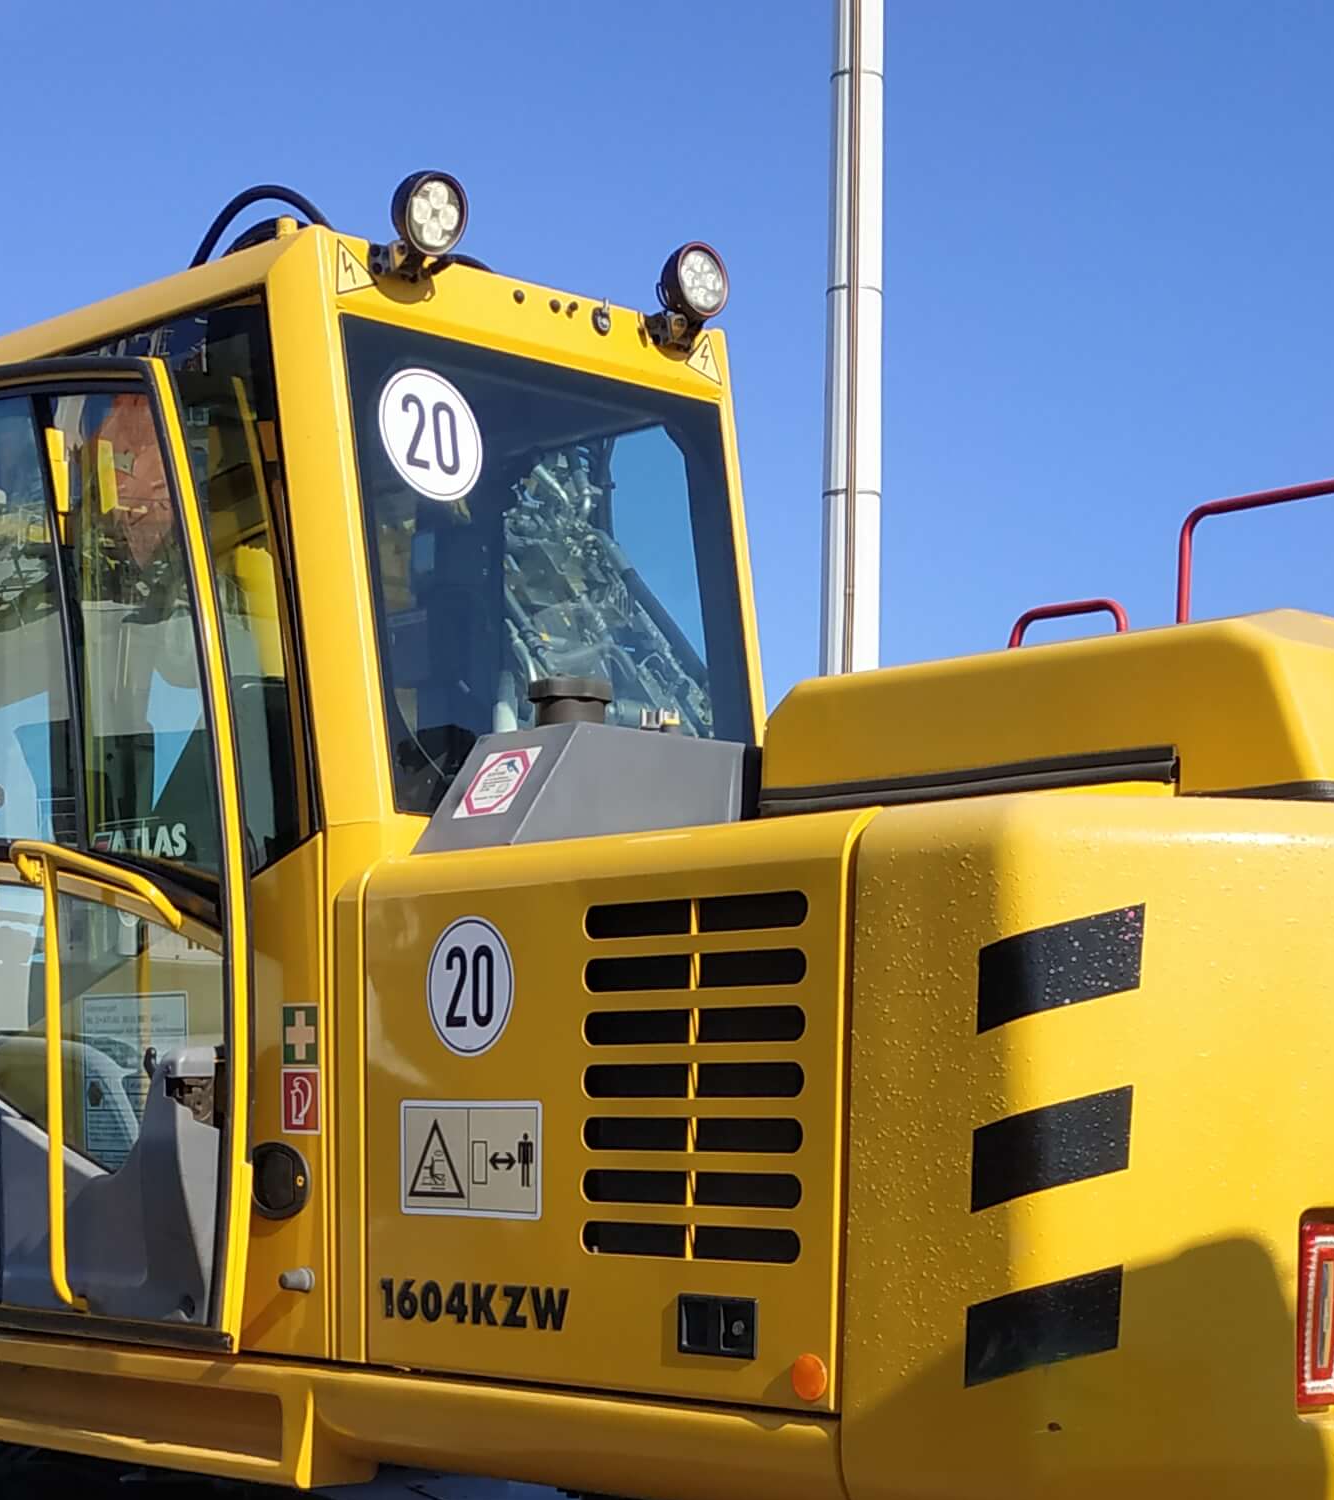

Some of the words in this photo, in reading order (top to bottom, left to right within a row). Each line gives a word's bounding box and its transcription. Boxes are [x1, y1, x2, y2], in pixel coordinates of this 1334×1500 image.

[402, 392, 460, 477] 20
[112, 822, 187, 857] ATLAS
[444, 944, 495, 1029] 20
[379, 1276, 570, 1332] 1604KZW
